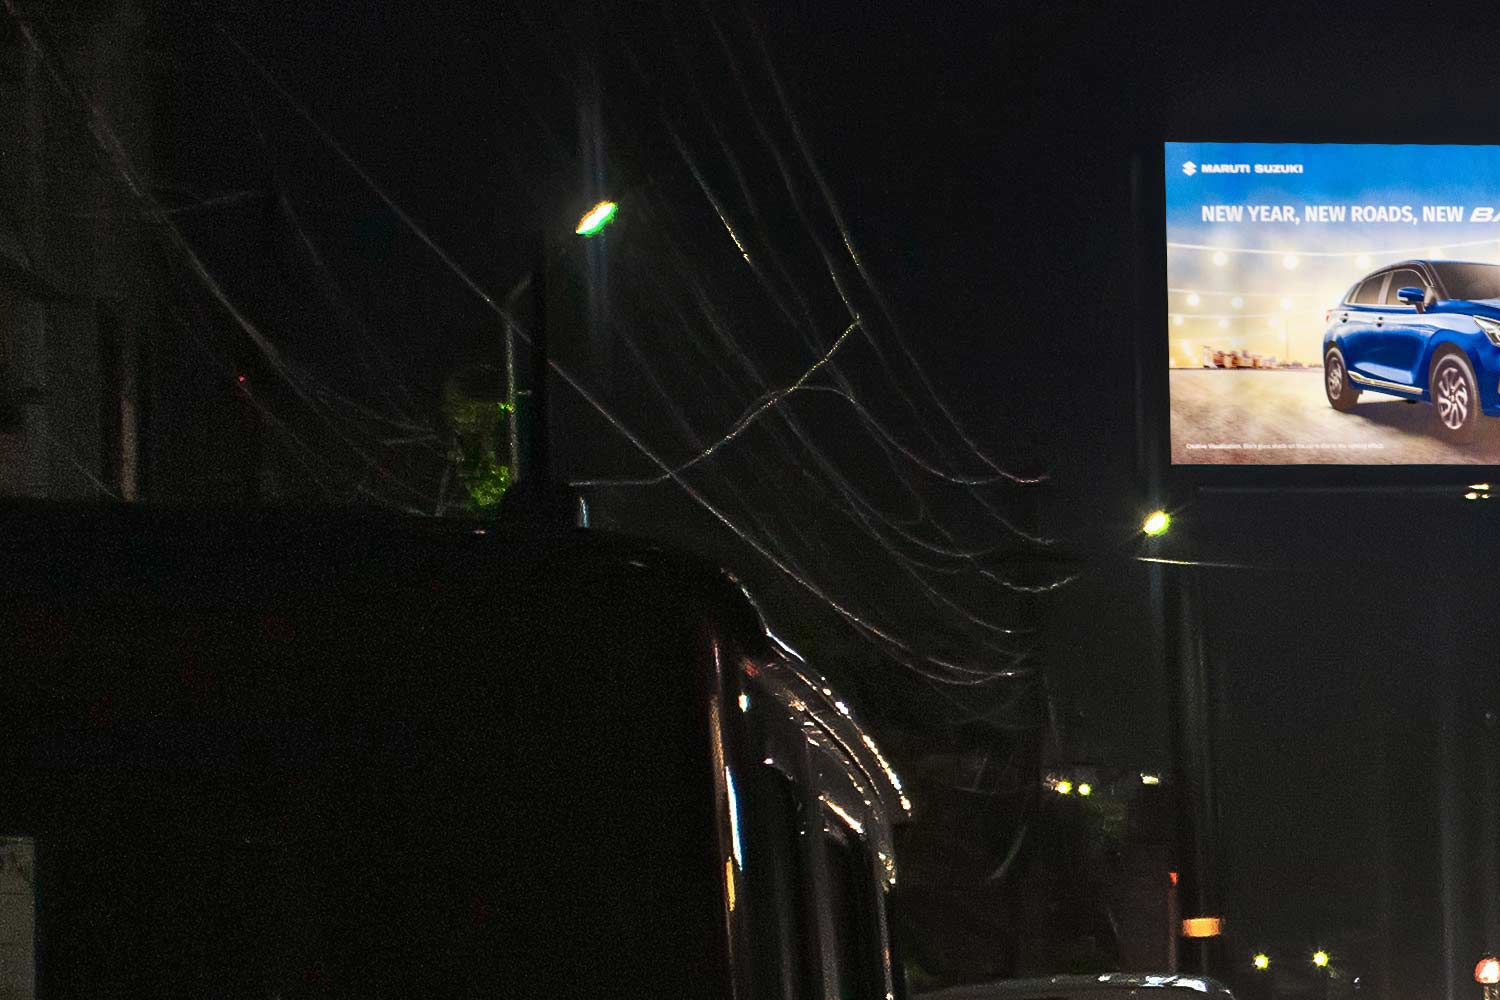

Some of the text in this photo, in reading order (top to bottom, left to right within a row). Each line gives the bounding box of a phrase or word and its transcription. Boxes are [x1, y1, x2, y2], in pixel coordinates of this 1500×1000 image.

[1201, 163, 1304, 174] MARUTI SUZUKI
[1201, 204, 1243, 222] NEW
[1246, 204, 1301, 226] YEAR,
[1304, 204, 1347, 222] NEW
[1351, 204, 1418, 225] ROADS,
[1422, 205, 1464, 222] NEW
